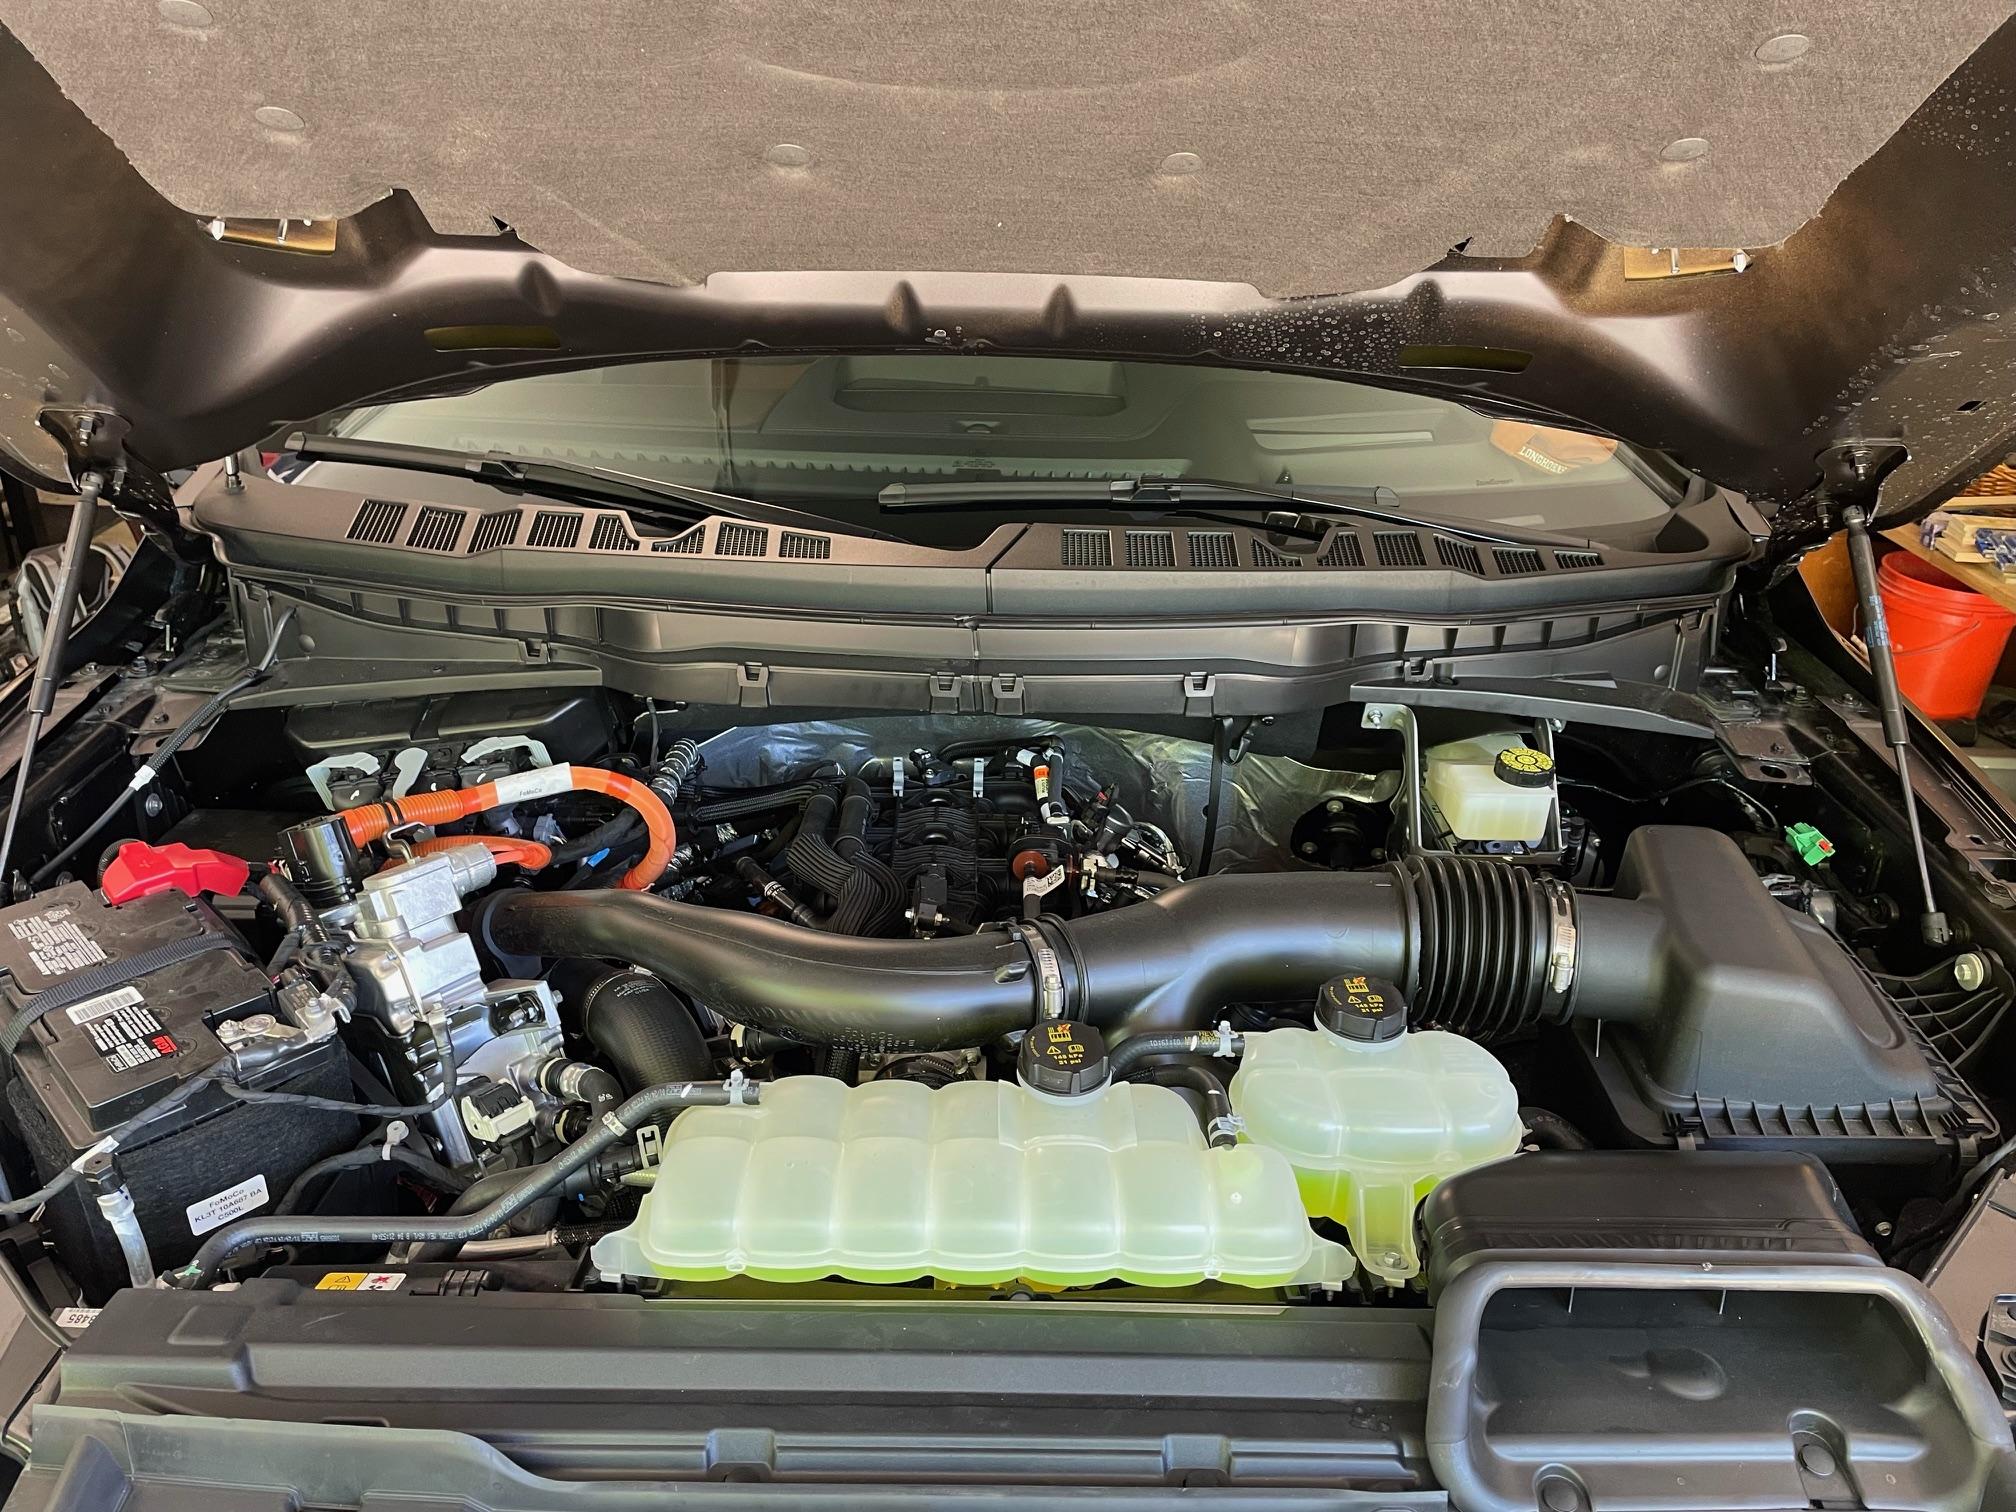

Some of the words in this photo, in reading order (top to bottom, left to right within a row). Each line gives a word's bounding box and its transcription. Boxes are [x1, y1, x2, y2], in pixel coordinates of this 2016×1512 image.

[209, 1188, 245, 1208] FoMoCo
[194, 1209, 217, 1223] KL3T
[217, 1206, 244, 1221] C500L
